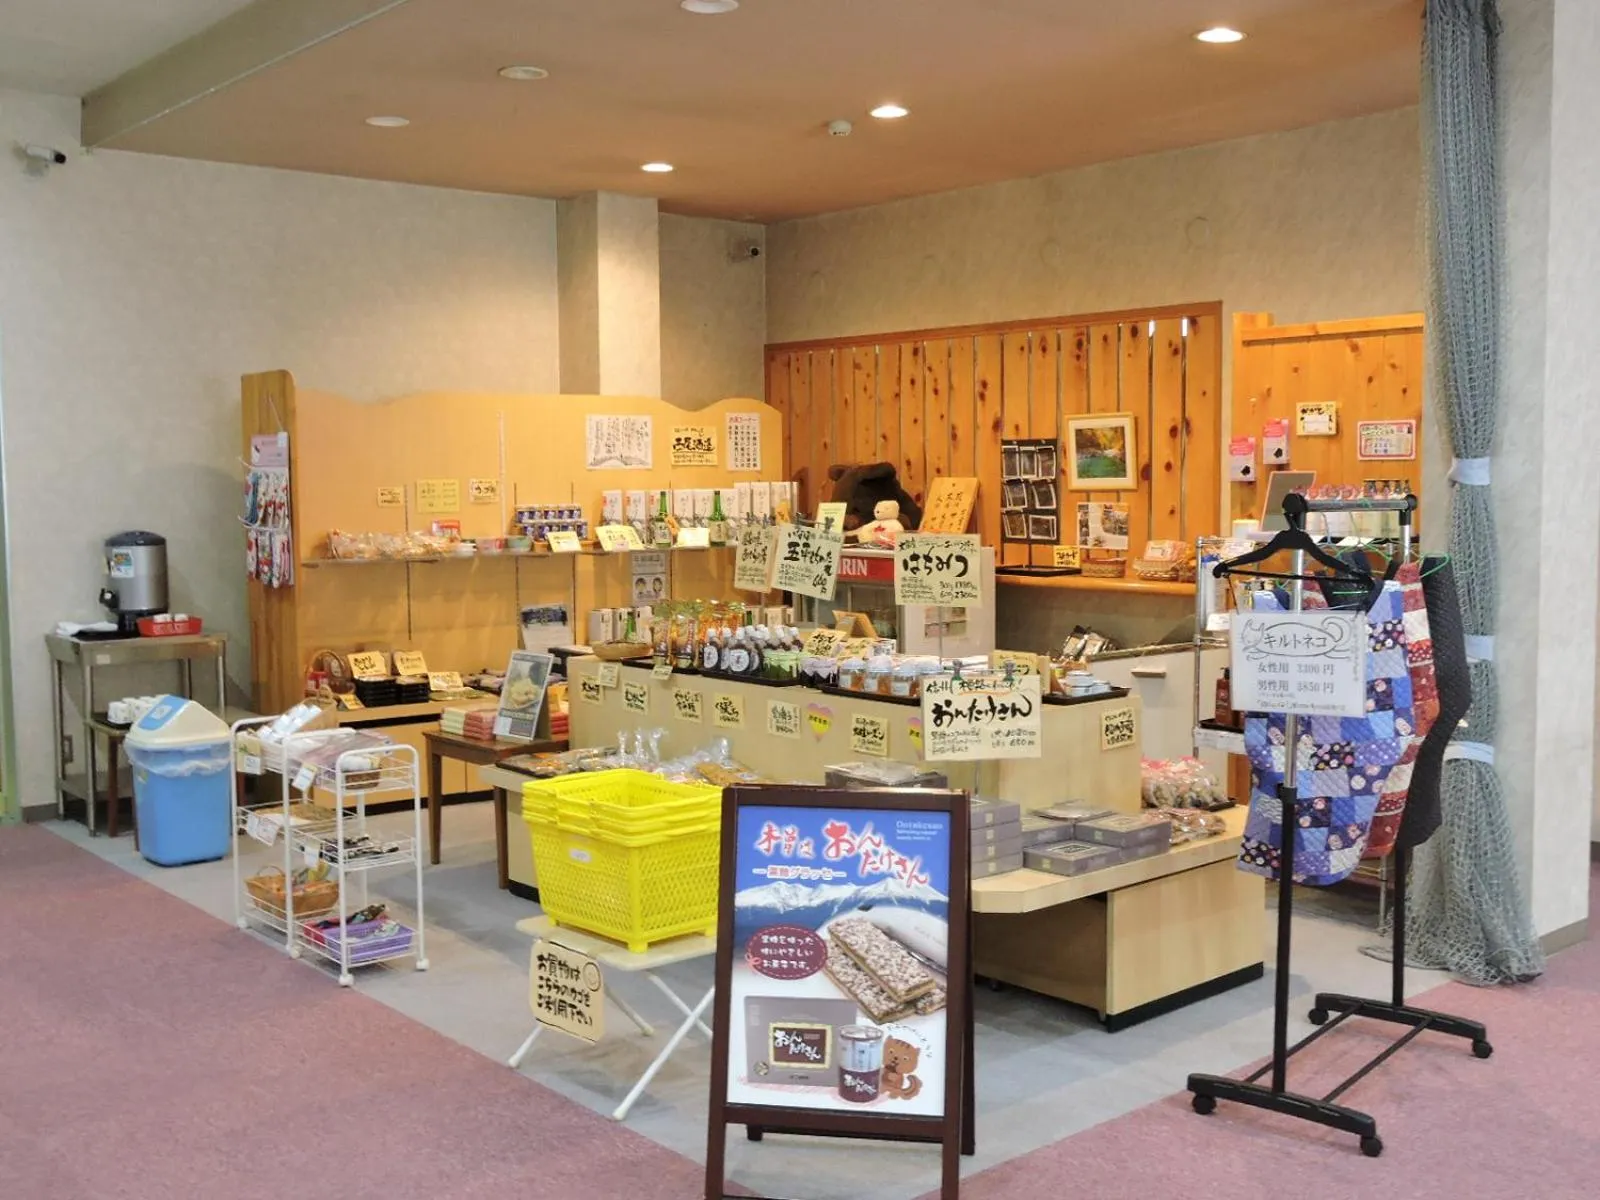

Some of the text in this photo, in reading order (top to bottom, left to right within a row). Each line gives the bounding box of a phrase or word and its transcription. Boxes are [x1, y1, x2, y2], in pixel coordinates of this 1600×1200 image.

[902, 546, 968, 577] はちみつ
[1264, 633, 1327, 649] キルトネコ
[1258, 662, 1289, 674] 女性用
[1258, 680, 1289, 692] 男性用
[931, 694, 1032, 728] おんたけさん
[823, 820, 929, 889] おんたけさん
